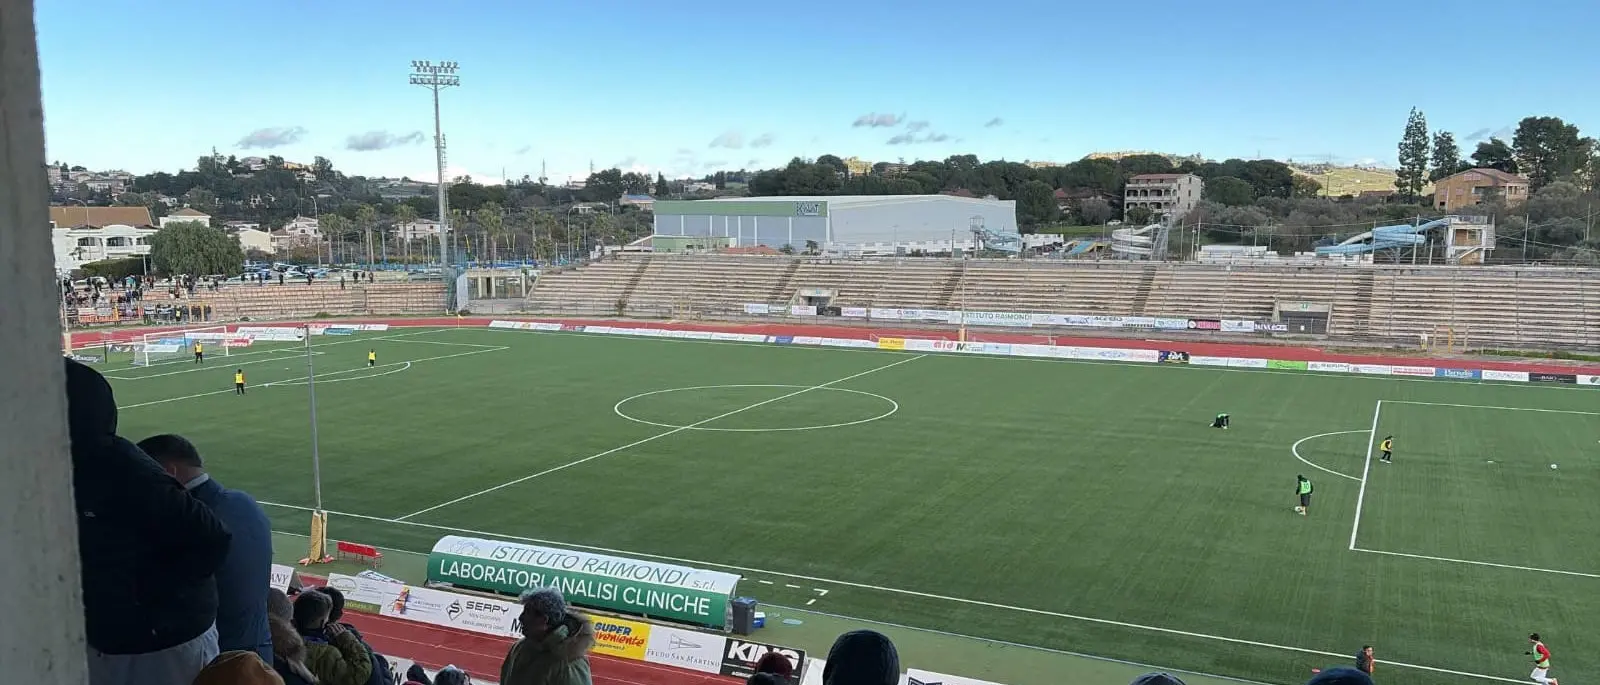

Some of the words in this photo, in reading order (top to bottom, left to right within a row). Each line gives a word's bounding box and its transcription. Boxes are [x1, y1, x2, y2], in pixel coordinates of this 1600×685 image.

[490, 545, 580, 569] ISTITUTO
[582, 557, 691, 586] RAIMONDI
[692, 578, 716, 591] s.r.l.
[440, 559, 546, 589] LABORATORI
[551, 575, 618, 602] ANALISI
[623, 586, 711, 616] CLINICHE
[594, 622, 632, 637] SUPER
[647, 648, 670, 659] FEUDO
[671, 652, 684, 661] SAN
[686, 655, 720, 667] MARTINO
